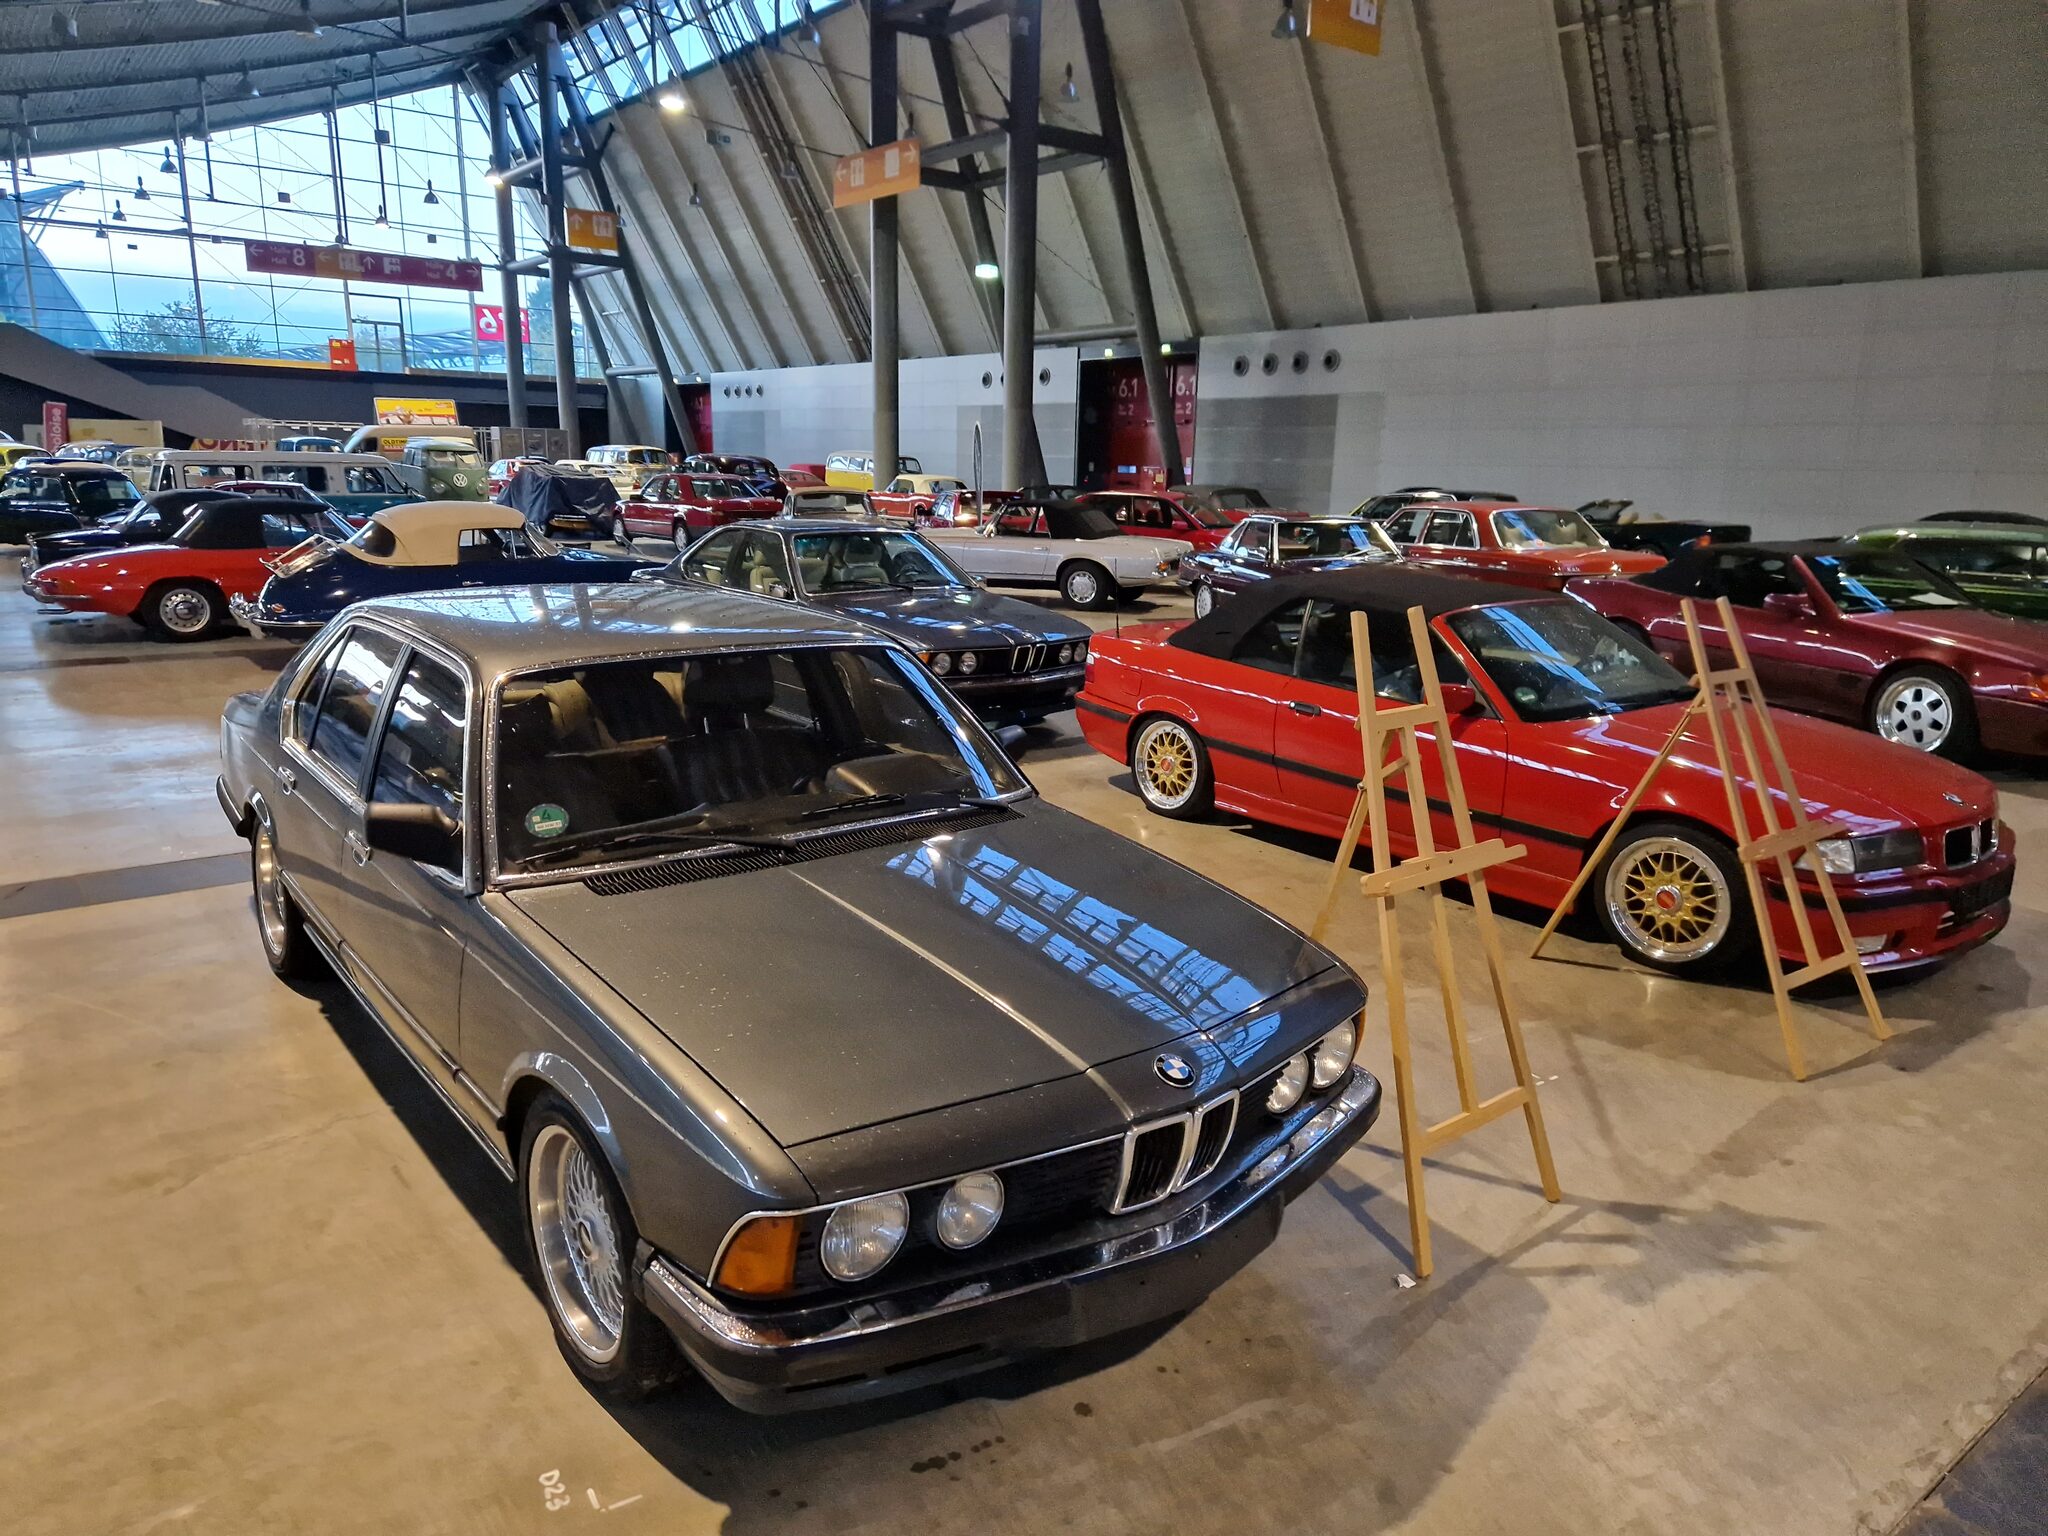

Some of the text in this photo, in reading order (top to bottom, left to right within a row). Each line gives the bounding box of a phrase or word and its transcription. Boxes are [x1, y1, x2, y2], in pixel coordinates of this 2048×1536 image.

[293, 248, 306, 266] 8
[446, 264, 458, 280] 4
[1119, 378, 1138, 397] 6.1
[1176, 375, 1196, 395] 6.1
[1185, 402, 1192, 414] 2
[538, 1468, 571, 1511] D23
